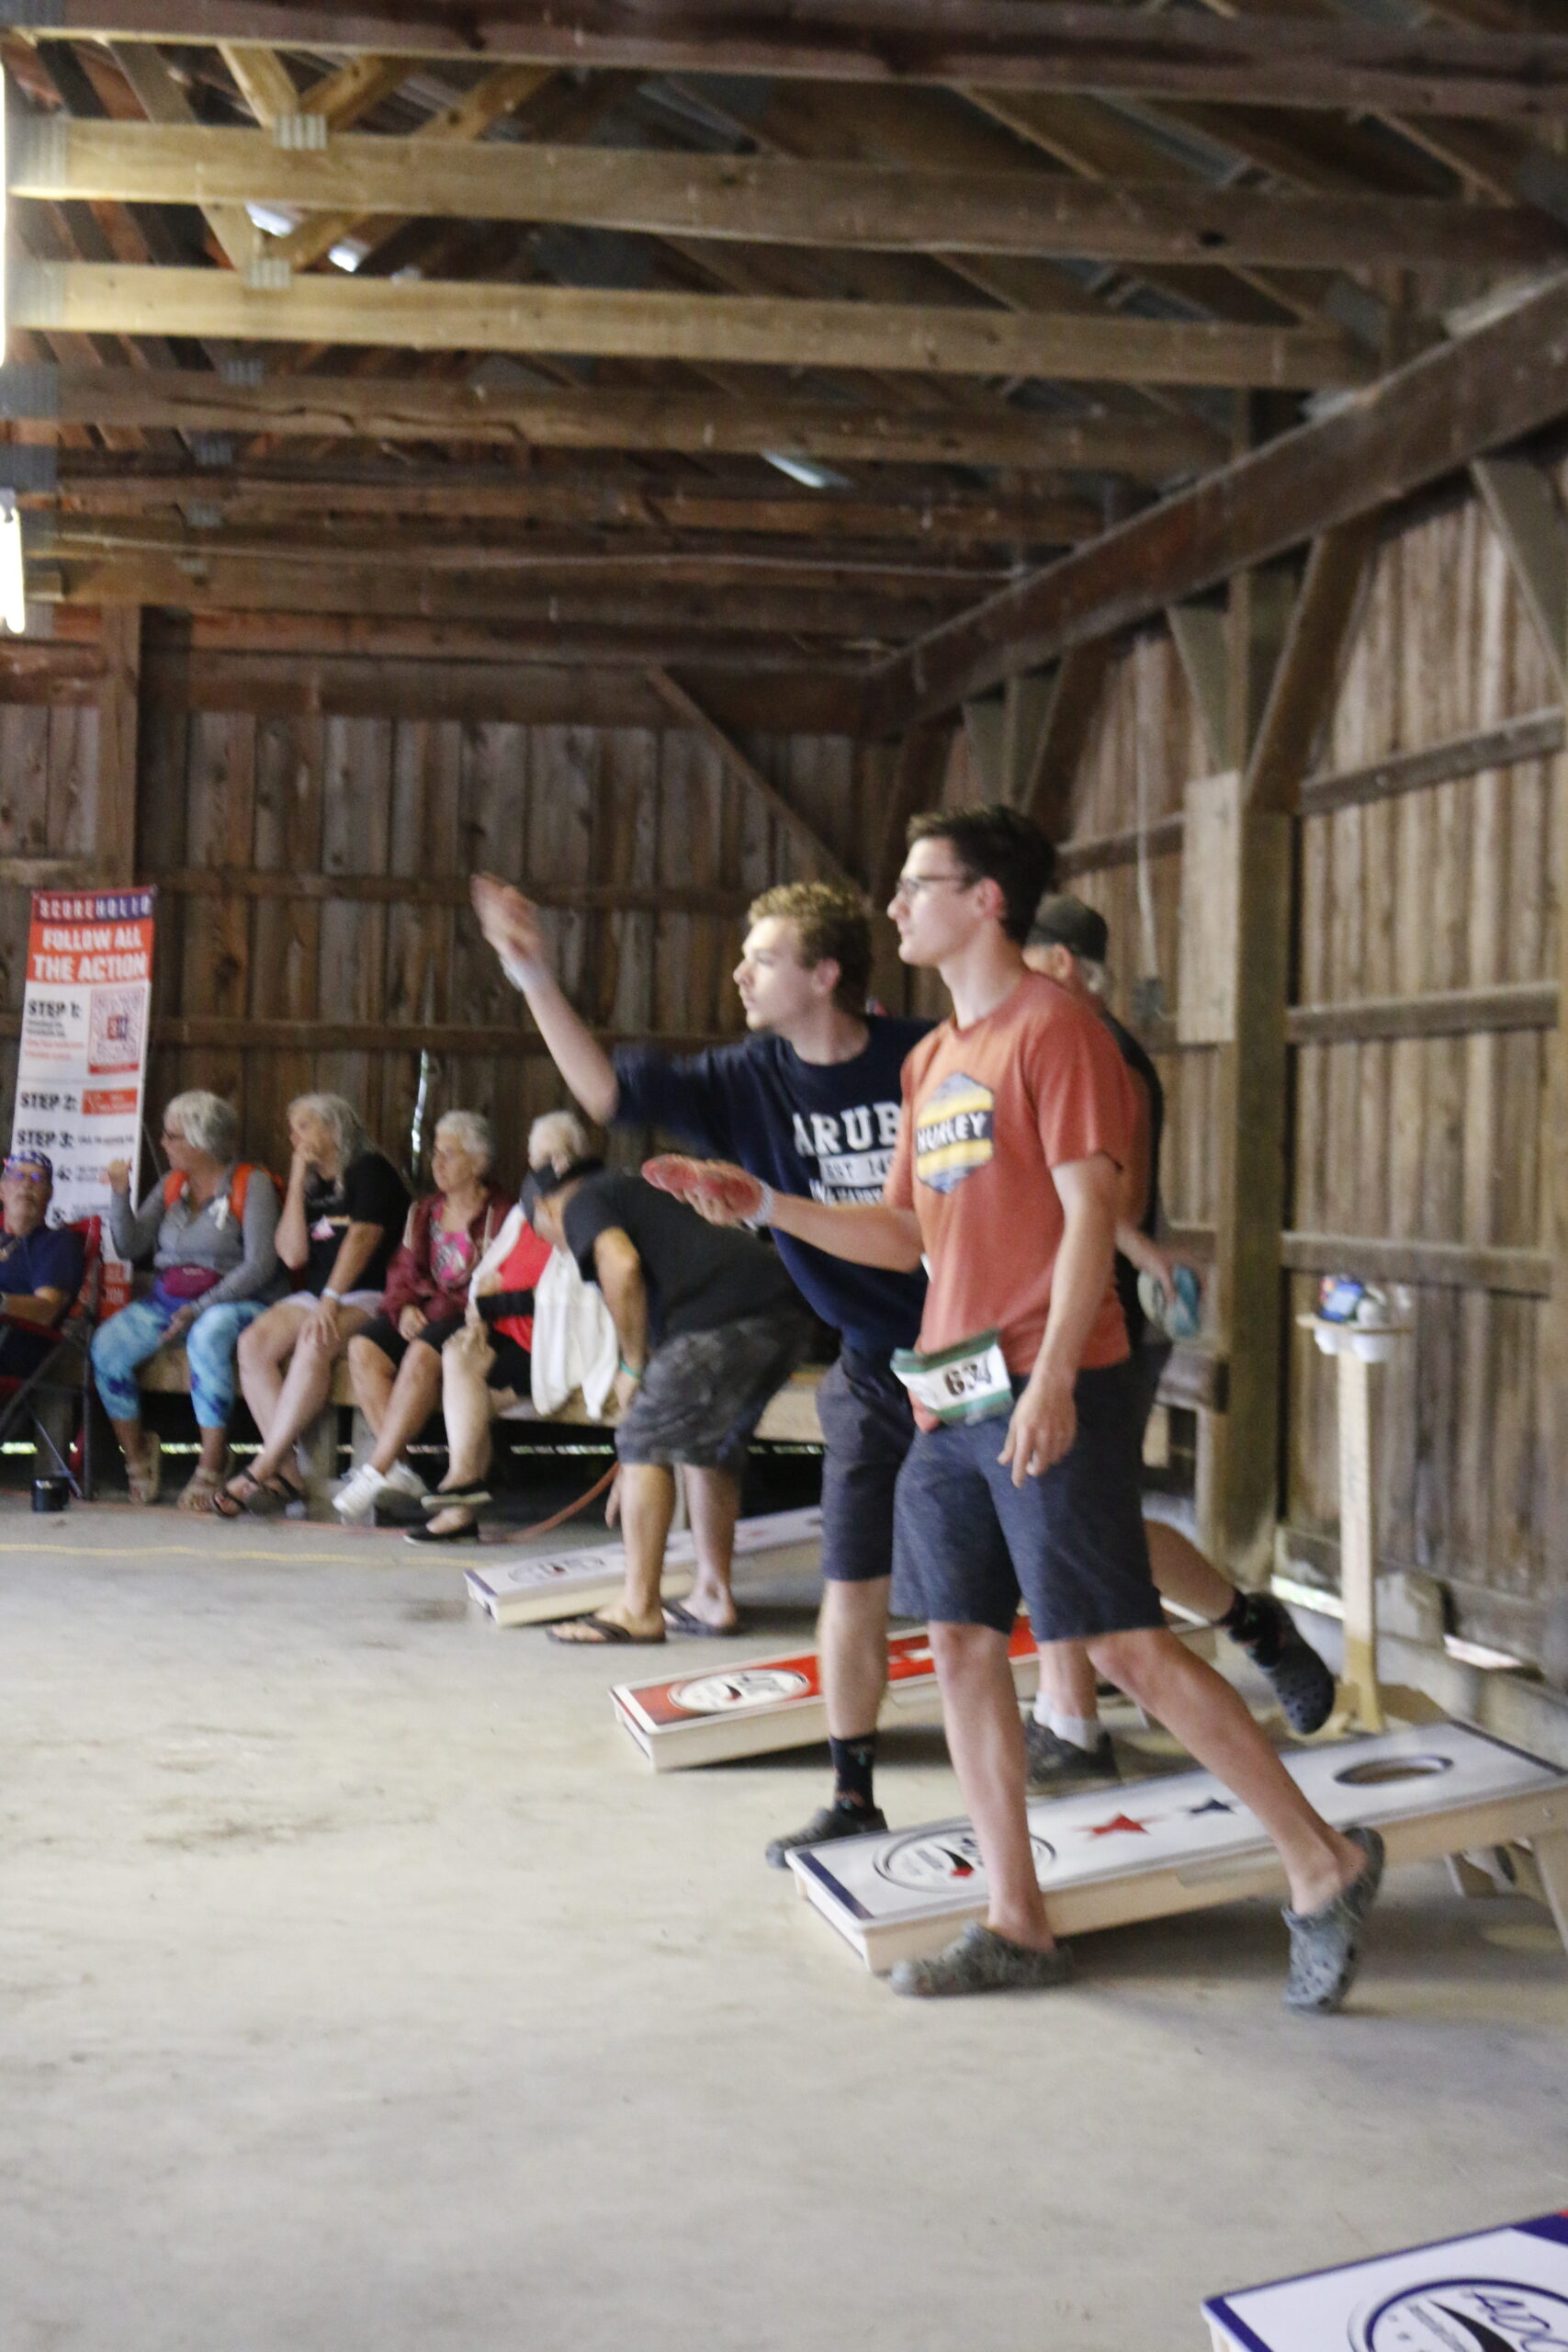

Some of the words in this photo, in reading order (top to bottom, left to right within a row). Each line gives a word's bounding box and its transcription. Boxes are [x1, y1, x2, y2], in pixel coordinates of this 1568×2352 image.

[42, 928, 111, 952] FOLLOW
[114, 926, 143, 950] ALL
[33, 954, 74, 981] THE
[77, 952, 147, 981] ACTION
[28, 999, 66, 1018] STEP
[20, 1092, 60, 1111] STEP
[17, 1130, 56, 1148] STEP
[793, 1101, 901, 1158] ARUB
